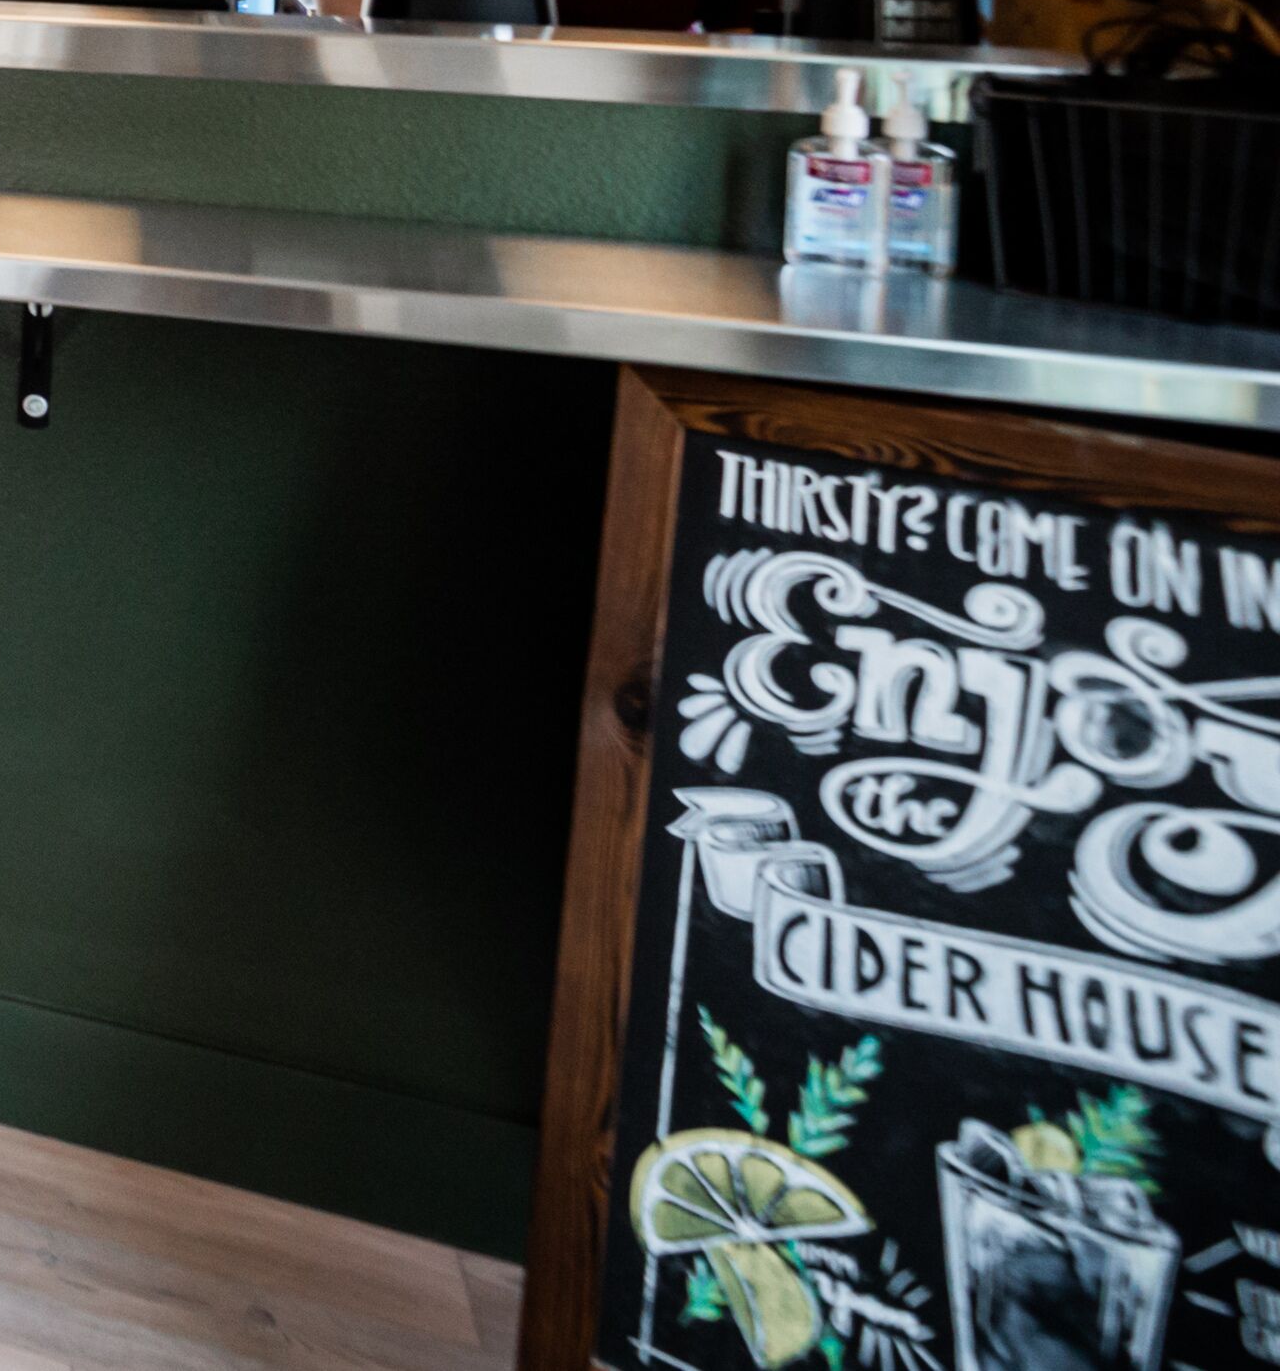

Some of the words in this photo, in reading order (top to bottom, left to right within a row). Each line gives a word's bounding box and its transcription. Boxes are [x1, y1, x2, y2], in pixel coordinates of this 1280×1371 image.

[715, 449, 938, 554] THIRSTY?
[946, 493, 1090, 591] COME
[1109, 513, 1202, 617] ON
[848, 775, 958, 837] the
[777, 911, 989, 1025] CIDER
[1015, 959, 1272, 1104] HOUSE
